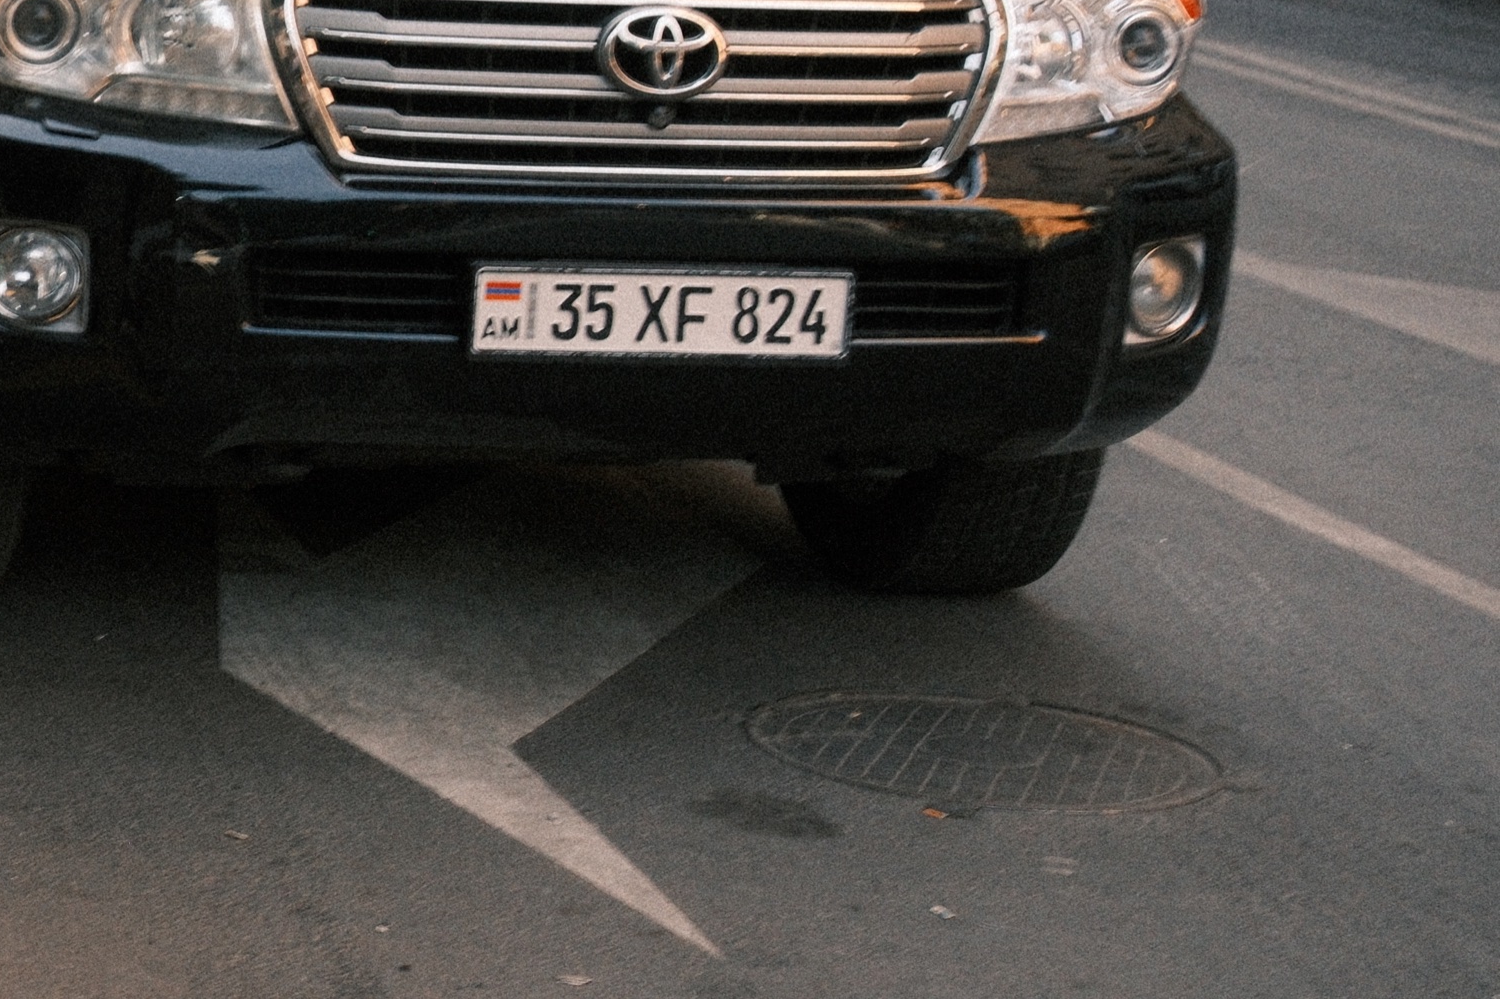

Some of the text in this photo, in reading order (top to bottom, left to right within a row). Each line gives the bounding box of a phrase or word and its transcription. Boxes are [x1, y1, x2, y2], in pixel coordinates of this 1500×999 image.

[481, 316, 520, 339] AM
[551, 284, 827, 345] 35 XF 824
